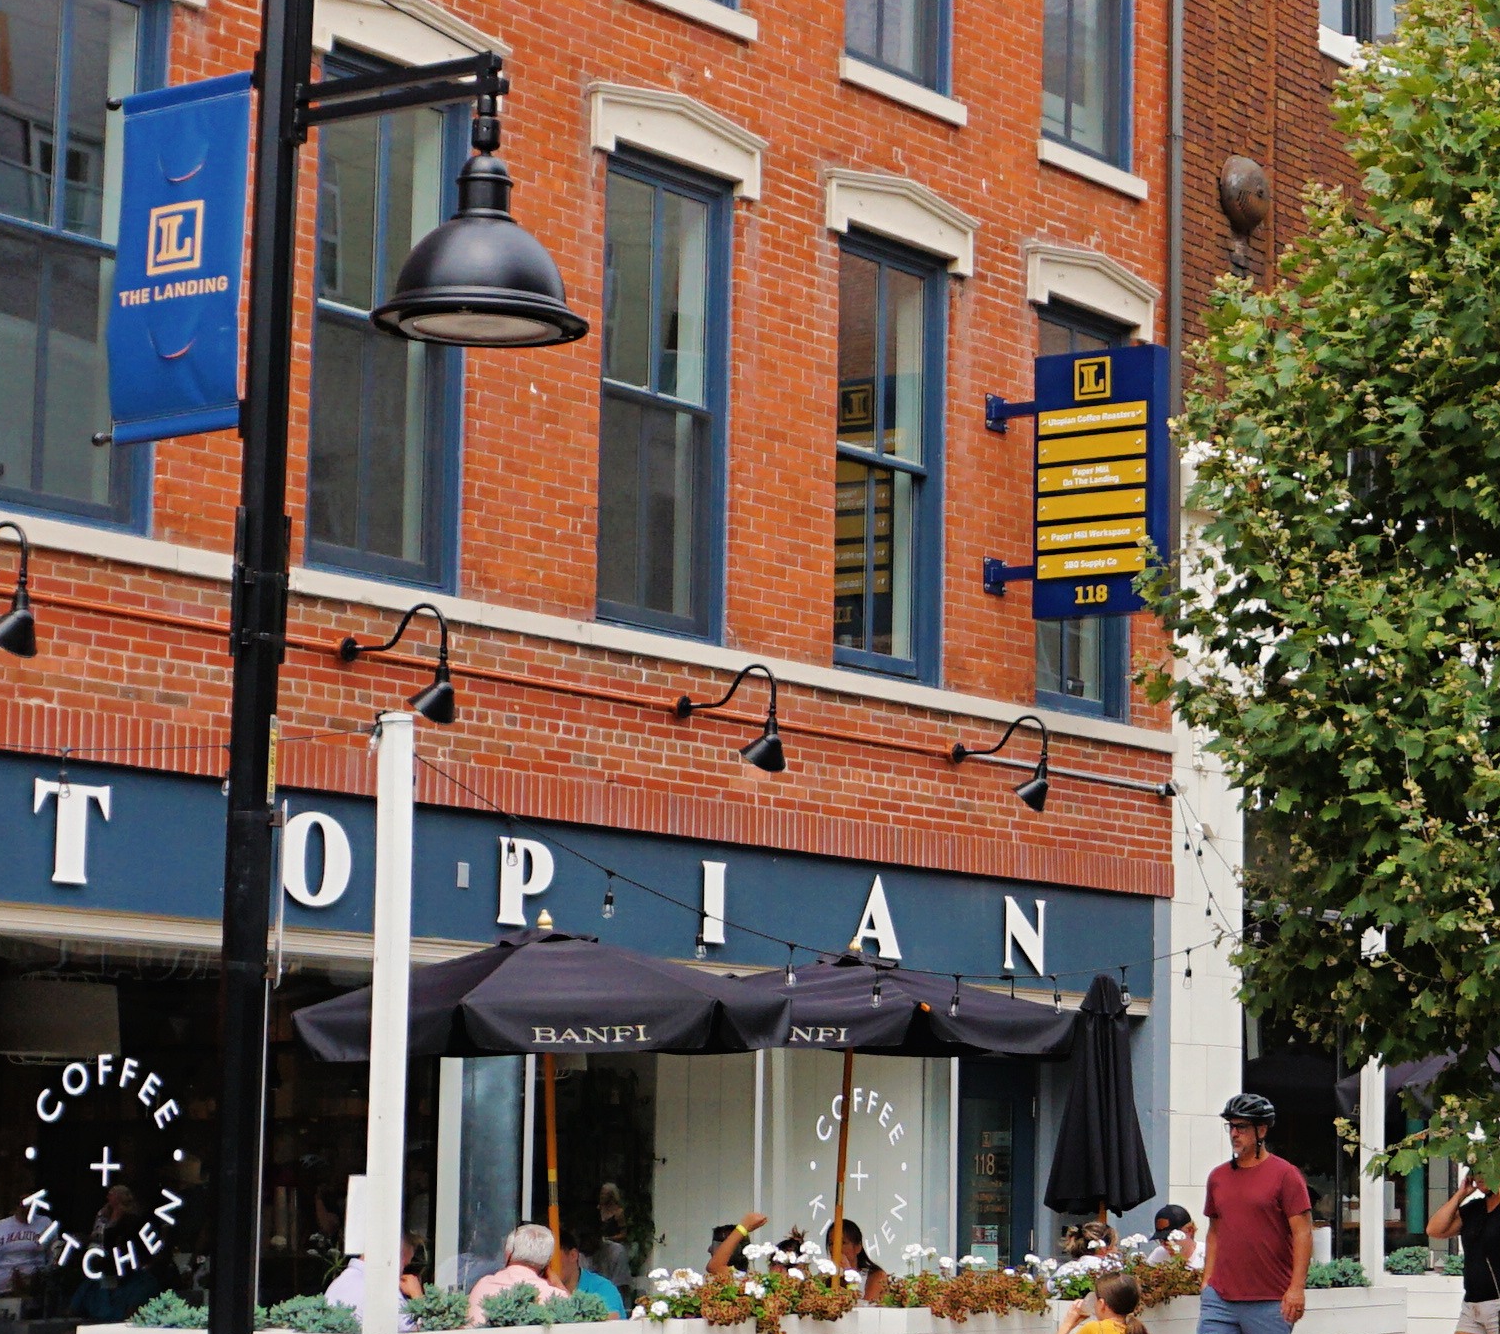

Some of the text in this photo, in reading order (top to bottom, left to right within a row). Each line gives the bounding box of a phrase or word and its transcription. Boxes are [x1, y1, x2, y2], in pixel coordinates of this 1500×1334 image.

[119, 275, 228, 307] THE LANDING
[1077, 413, 1101, 423] Coffee
[1050, 528, 1131, 542] Paper Mill Workspace
[1080, 558, 1106, 568] Supply
[1106, 557, 1117, 566] Co
[1074, 584, 1108, 605] 118
[531, 1024, 649, 1044] BANFI
[789, 1025, 849, 1043] NFI
[36, 1053, 180, 1130] COFFEE
[816, 1087, 904, 1146] COFFEE
[974, 1153, 995, 1175] 118
[22, 1188, 182, 1280] KITCHEN
[808, 1193, 908, 1258] KIHEN
